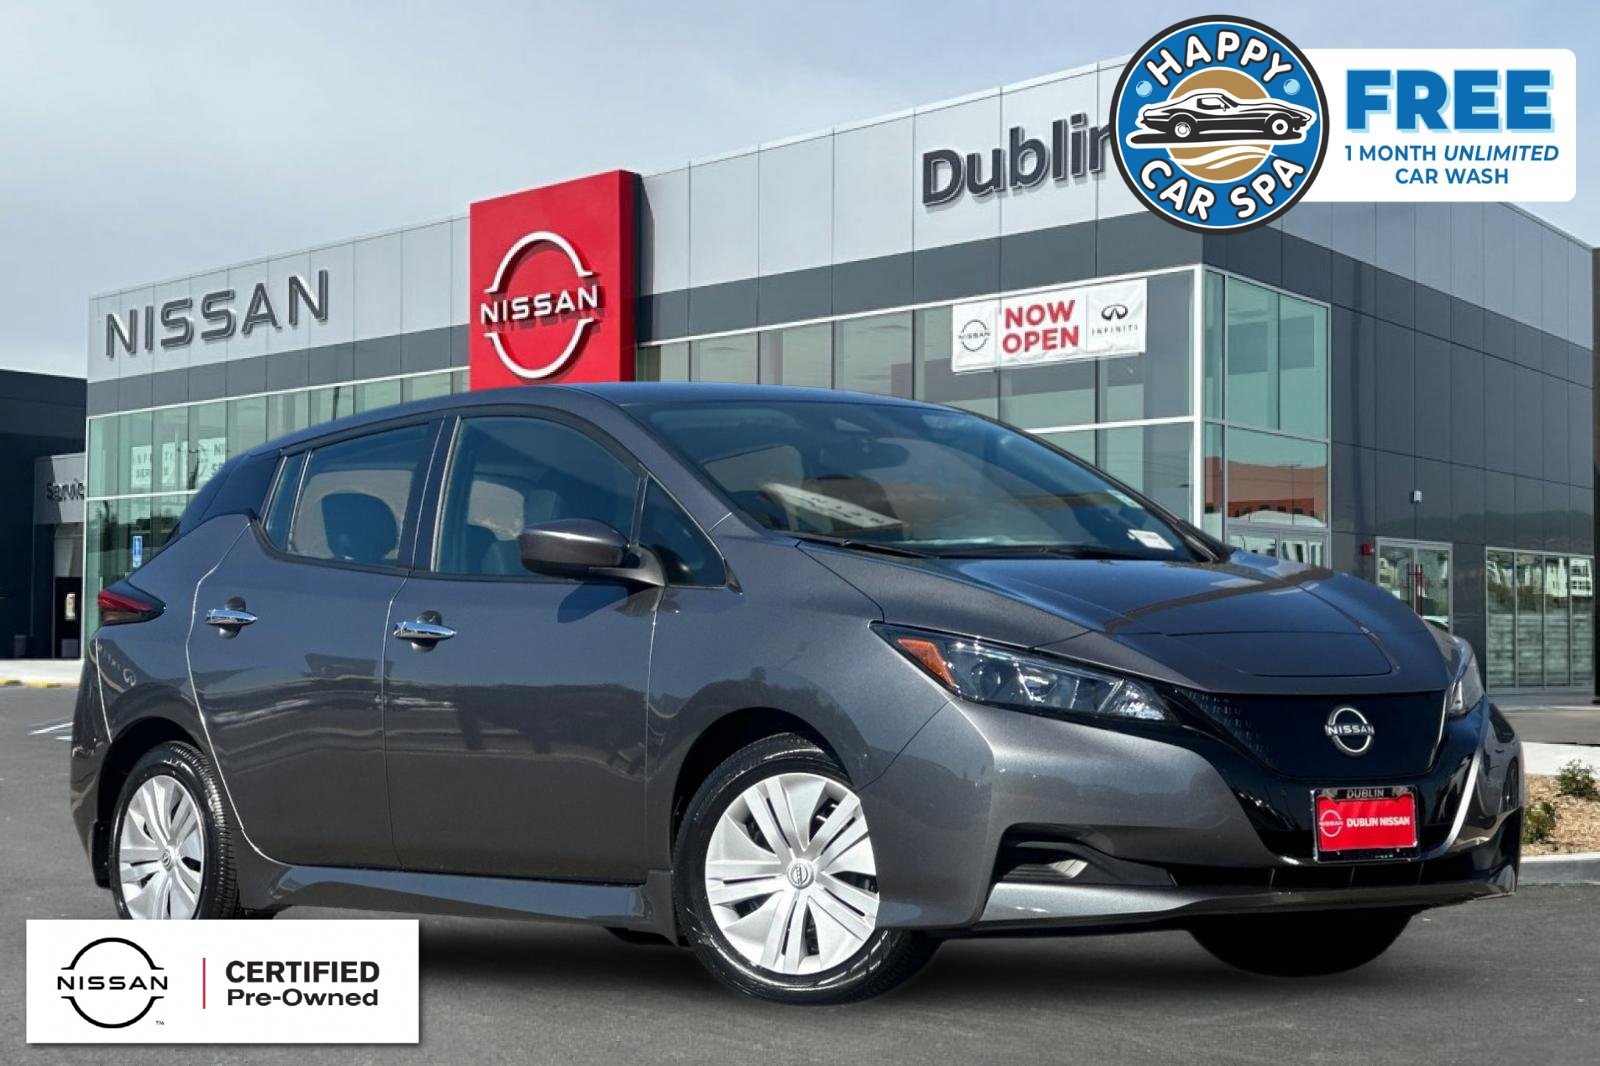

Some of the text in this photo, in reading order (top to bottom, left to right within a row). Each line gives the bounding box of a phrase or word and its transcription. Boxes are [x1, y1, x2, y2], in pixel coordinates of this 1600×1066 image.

[106, 269, 328, 358] NISSAN
[481, 285, 598, 325] NISSAN
[1004, 299, 1076, 329] NOW
[1002, 325, 1080, 354] OPEN
[1325, 724, 1374, 736] NISSAN
[1346, 788, 1384, 799] DUBLIN
[1346, 816, 1378, 828] DUBLIN
[1379, 815, 1410, 827] NISSAN
